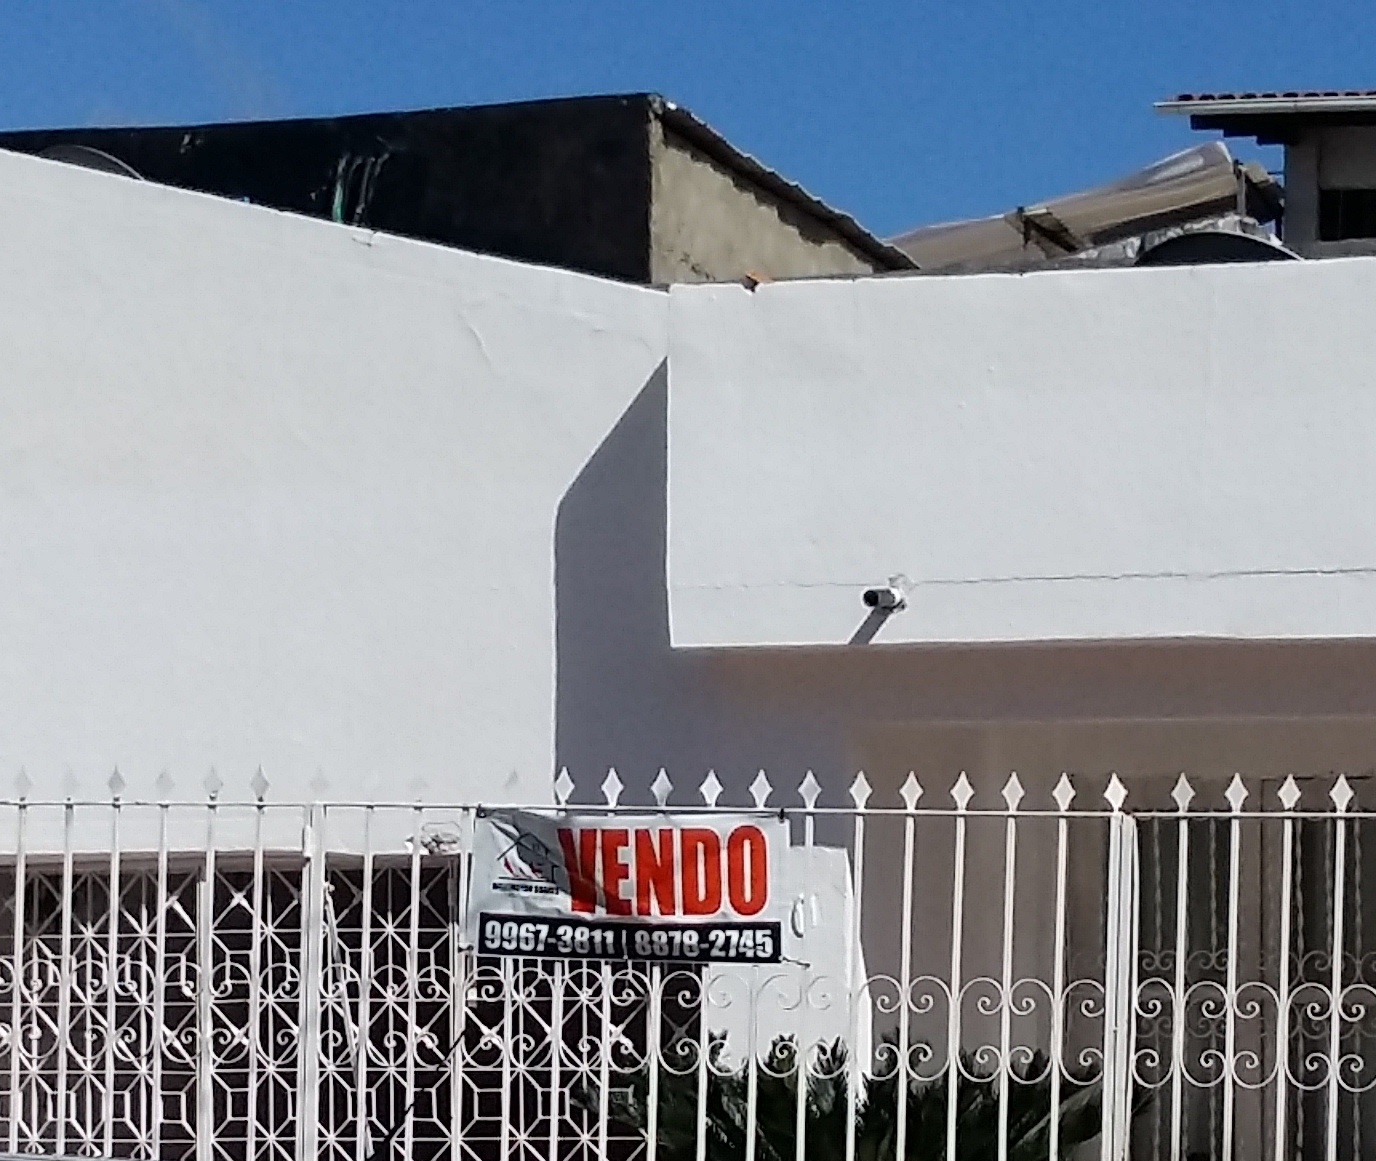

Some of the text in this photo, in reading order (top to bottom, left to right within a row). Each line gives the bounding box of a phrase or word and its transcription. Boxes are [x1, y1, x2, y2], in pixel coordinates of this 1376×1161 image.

[556, 825, 768, 916] VENDO
[484, 920, 774, 958] 9967-3811 8878-2745
